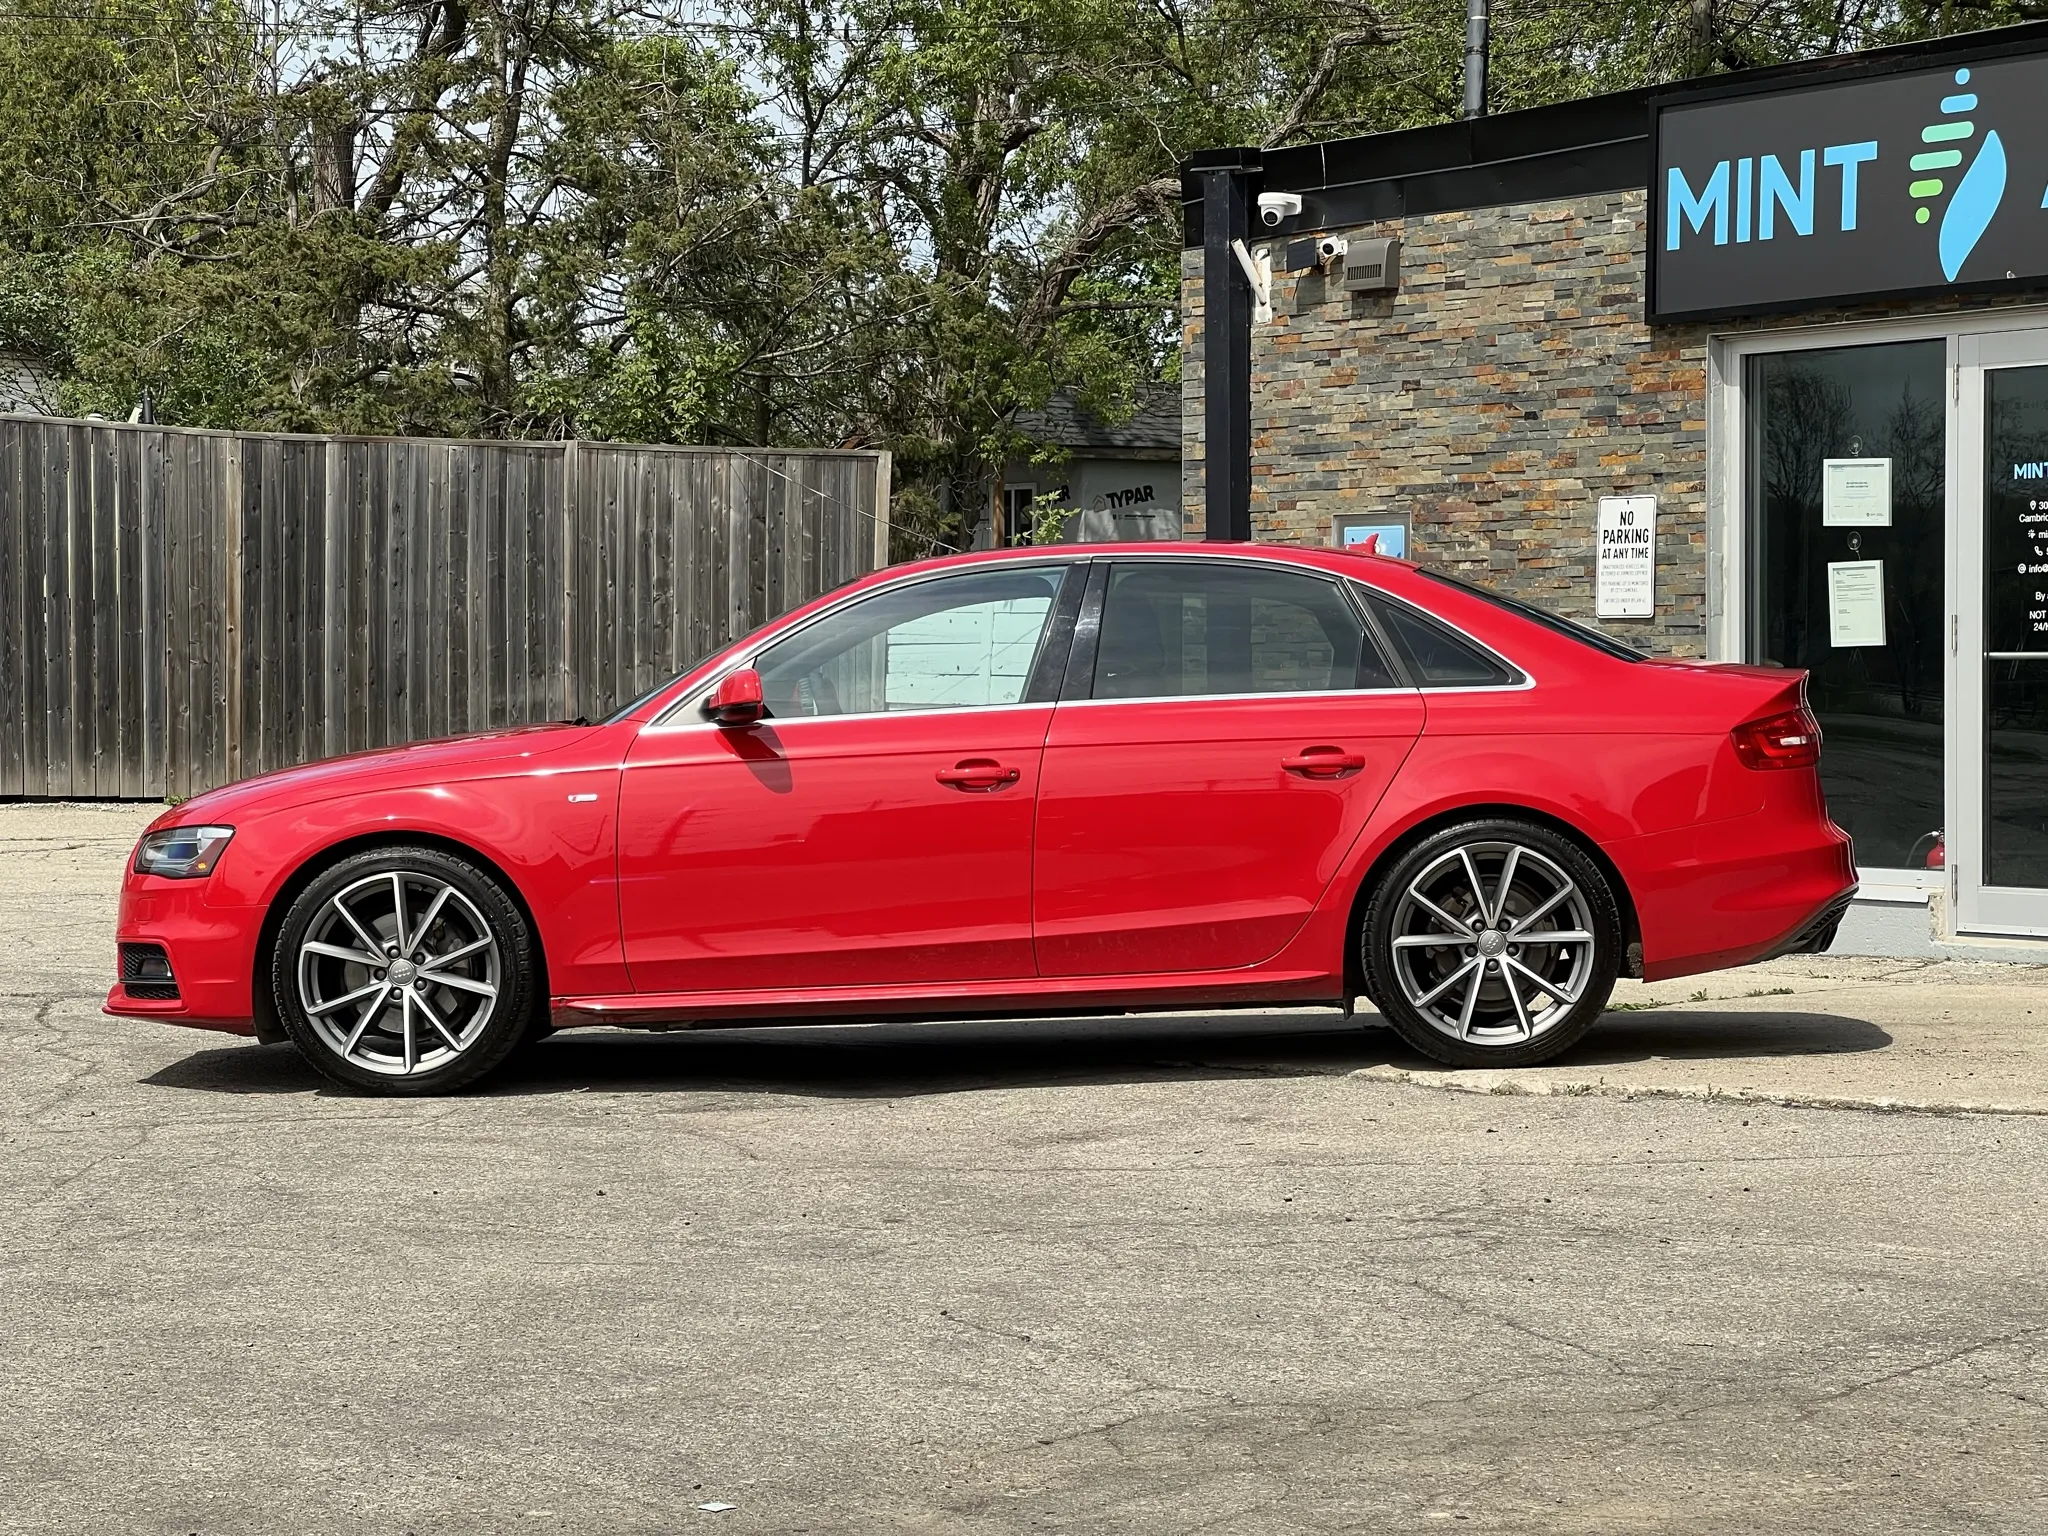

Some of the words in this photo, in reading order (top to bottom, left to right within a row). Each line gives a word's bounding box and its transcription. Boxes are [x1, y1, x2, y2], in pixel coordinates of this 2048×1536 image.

[1666, 141, 1878, 251] MINT
[1105, 485, 1155, 509] TYPAR
[1619, 511, 1634, 526] NO
[1603, 528, 1649, 545] PARKING
[1602, 548, 1612, 559] AT
[1613, 548, 1629, 559] ANY
[1631, 547, 1649, 559] TIME
[2035, 591, 2046, 602] By
[2029, 610, 2047, 619] NOT
